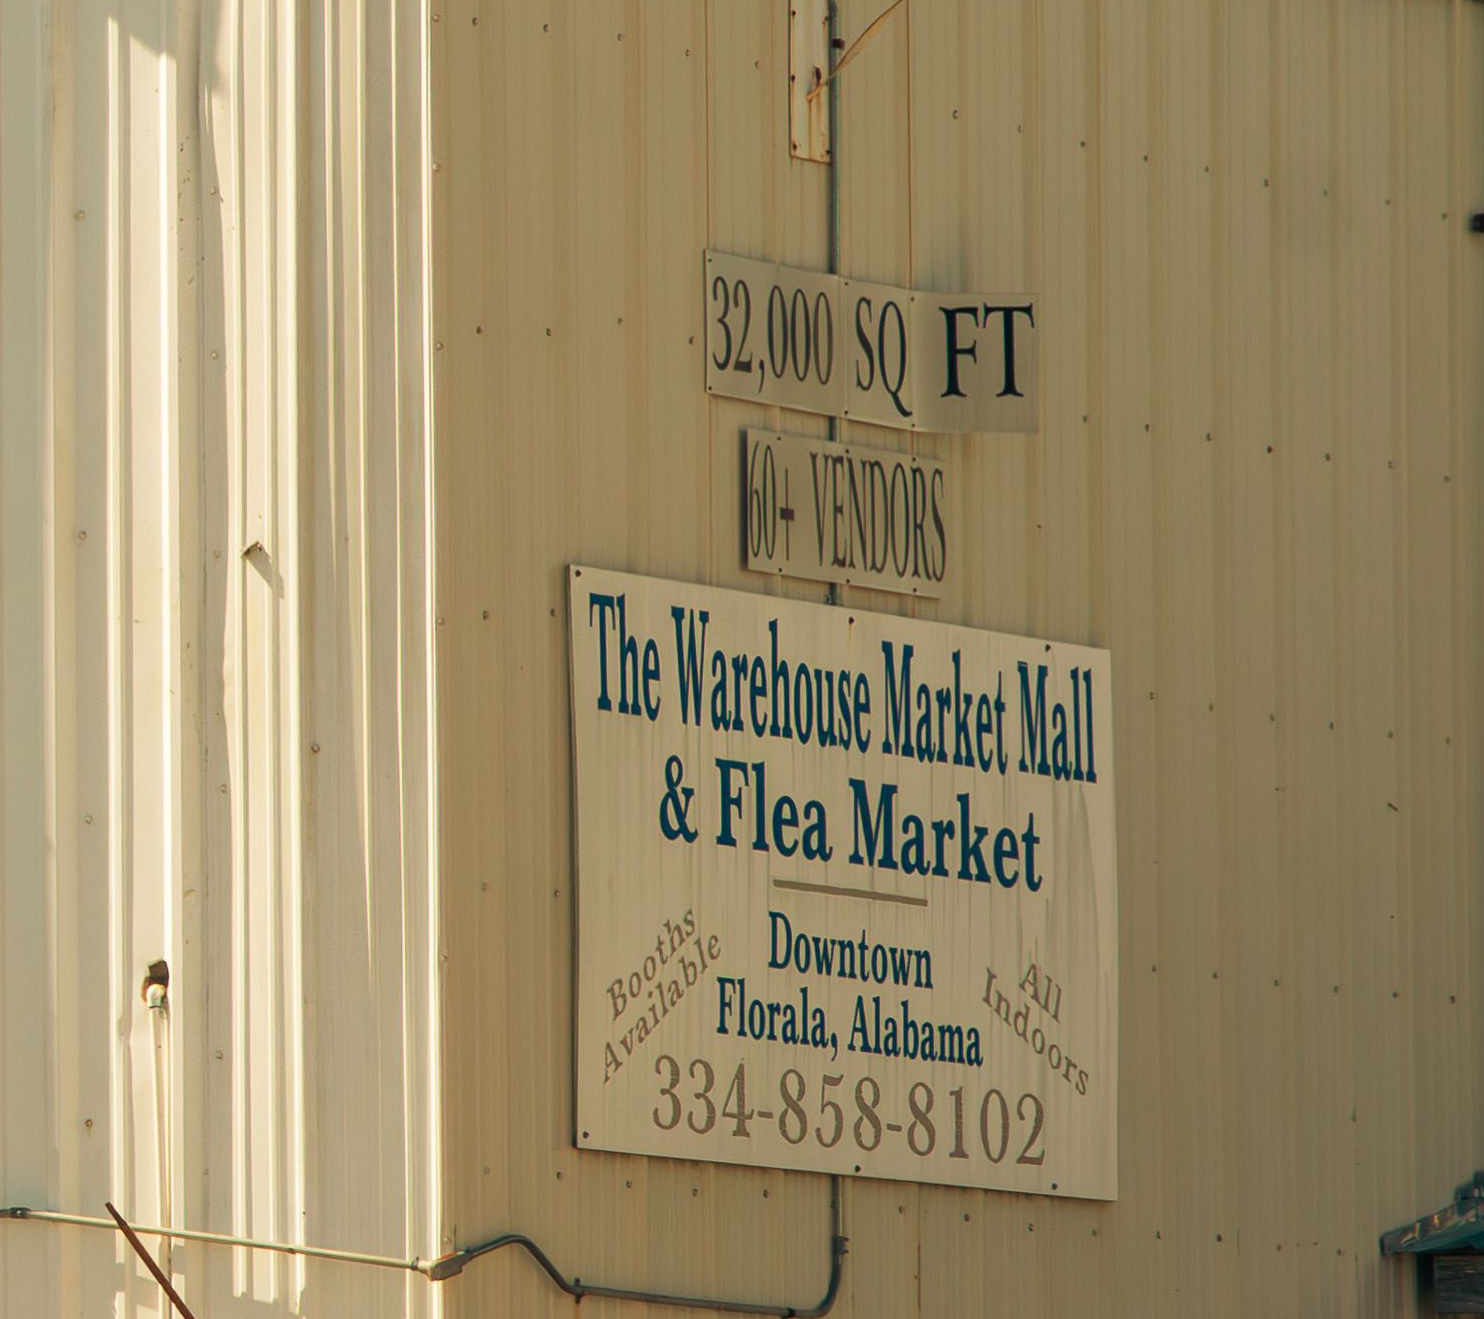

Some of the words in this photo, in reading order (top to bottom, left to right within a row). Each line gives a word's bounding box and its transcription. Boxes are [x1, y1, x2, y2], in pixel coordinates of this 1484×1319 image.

[712, 275, 834, 394] 32,000
[855, 296, 913, 417] SQ
[938, 302, 1035, 398] FT
[749, 440, 795, 561] 60+
[809, 451, 946, 582] VENDORS
[589, 591, 661, 722] The
[670, 604, 871, 753] Warehouse
[881, 640, 1008, 776] Market
[1017, 660, 1098, 784] Mall
[659, 754, 698, 844] &
[715, 757, 833, 862] Flea
[848, 777, 1042, 893] Market
[603, 930, 722, 1084] Available
[605, 907, 696, 1022] Booths
[768, 910, 934, 989] Downtown
[1018, 962, 1062, 1024] All
[716, 976, 839, 1062] Florala,
[847, 995, 984, 1067] Alabama
[982, 967, 1090, 1097] Indoors
[652, 1053, 1046, 1166] 334-858-8102
